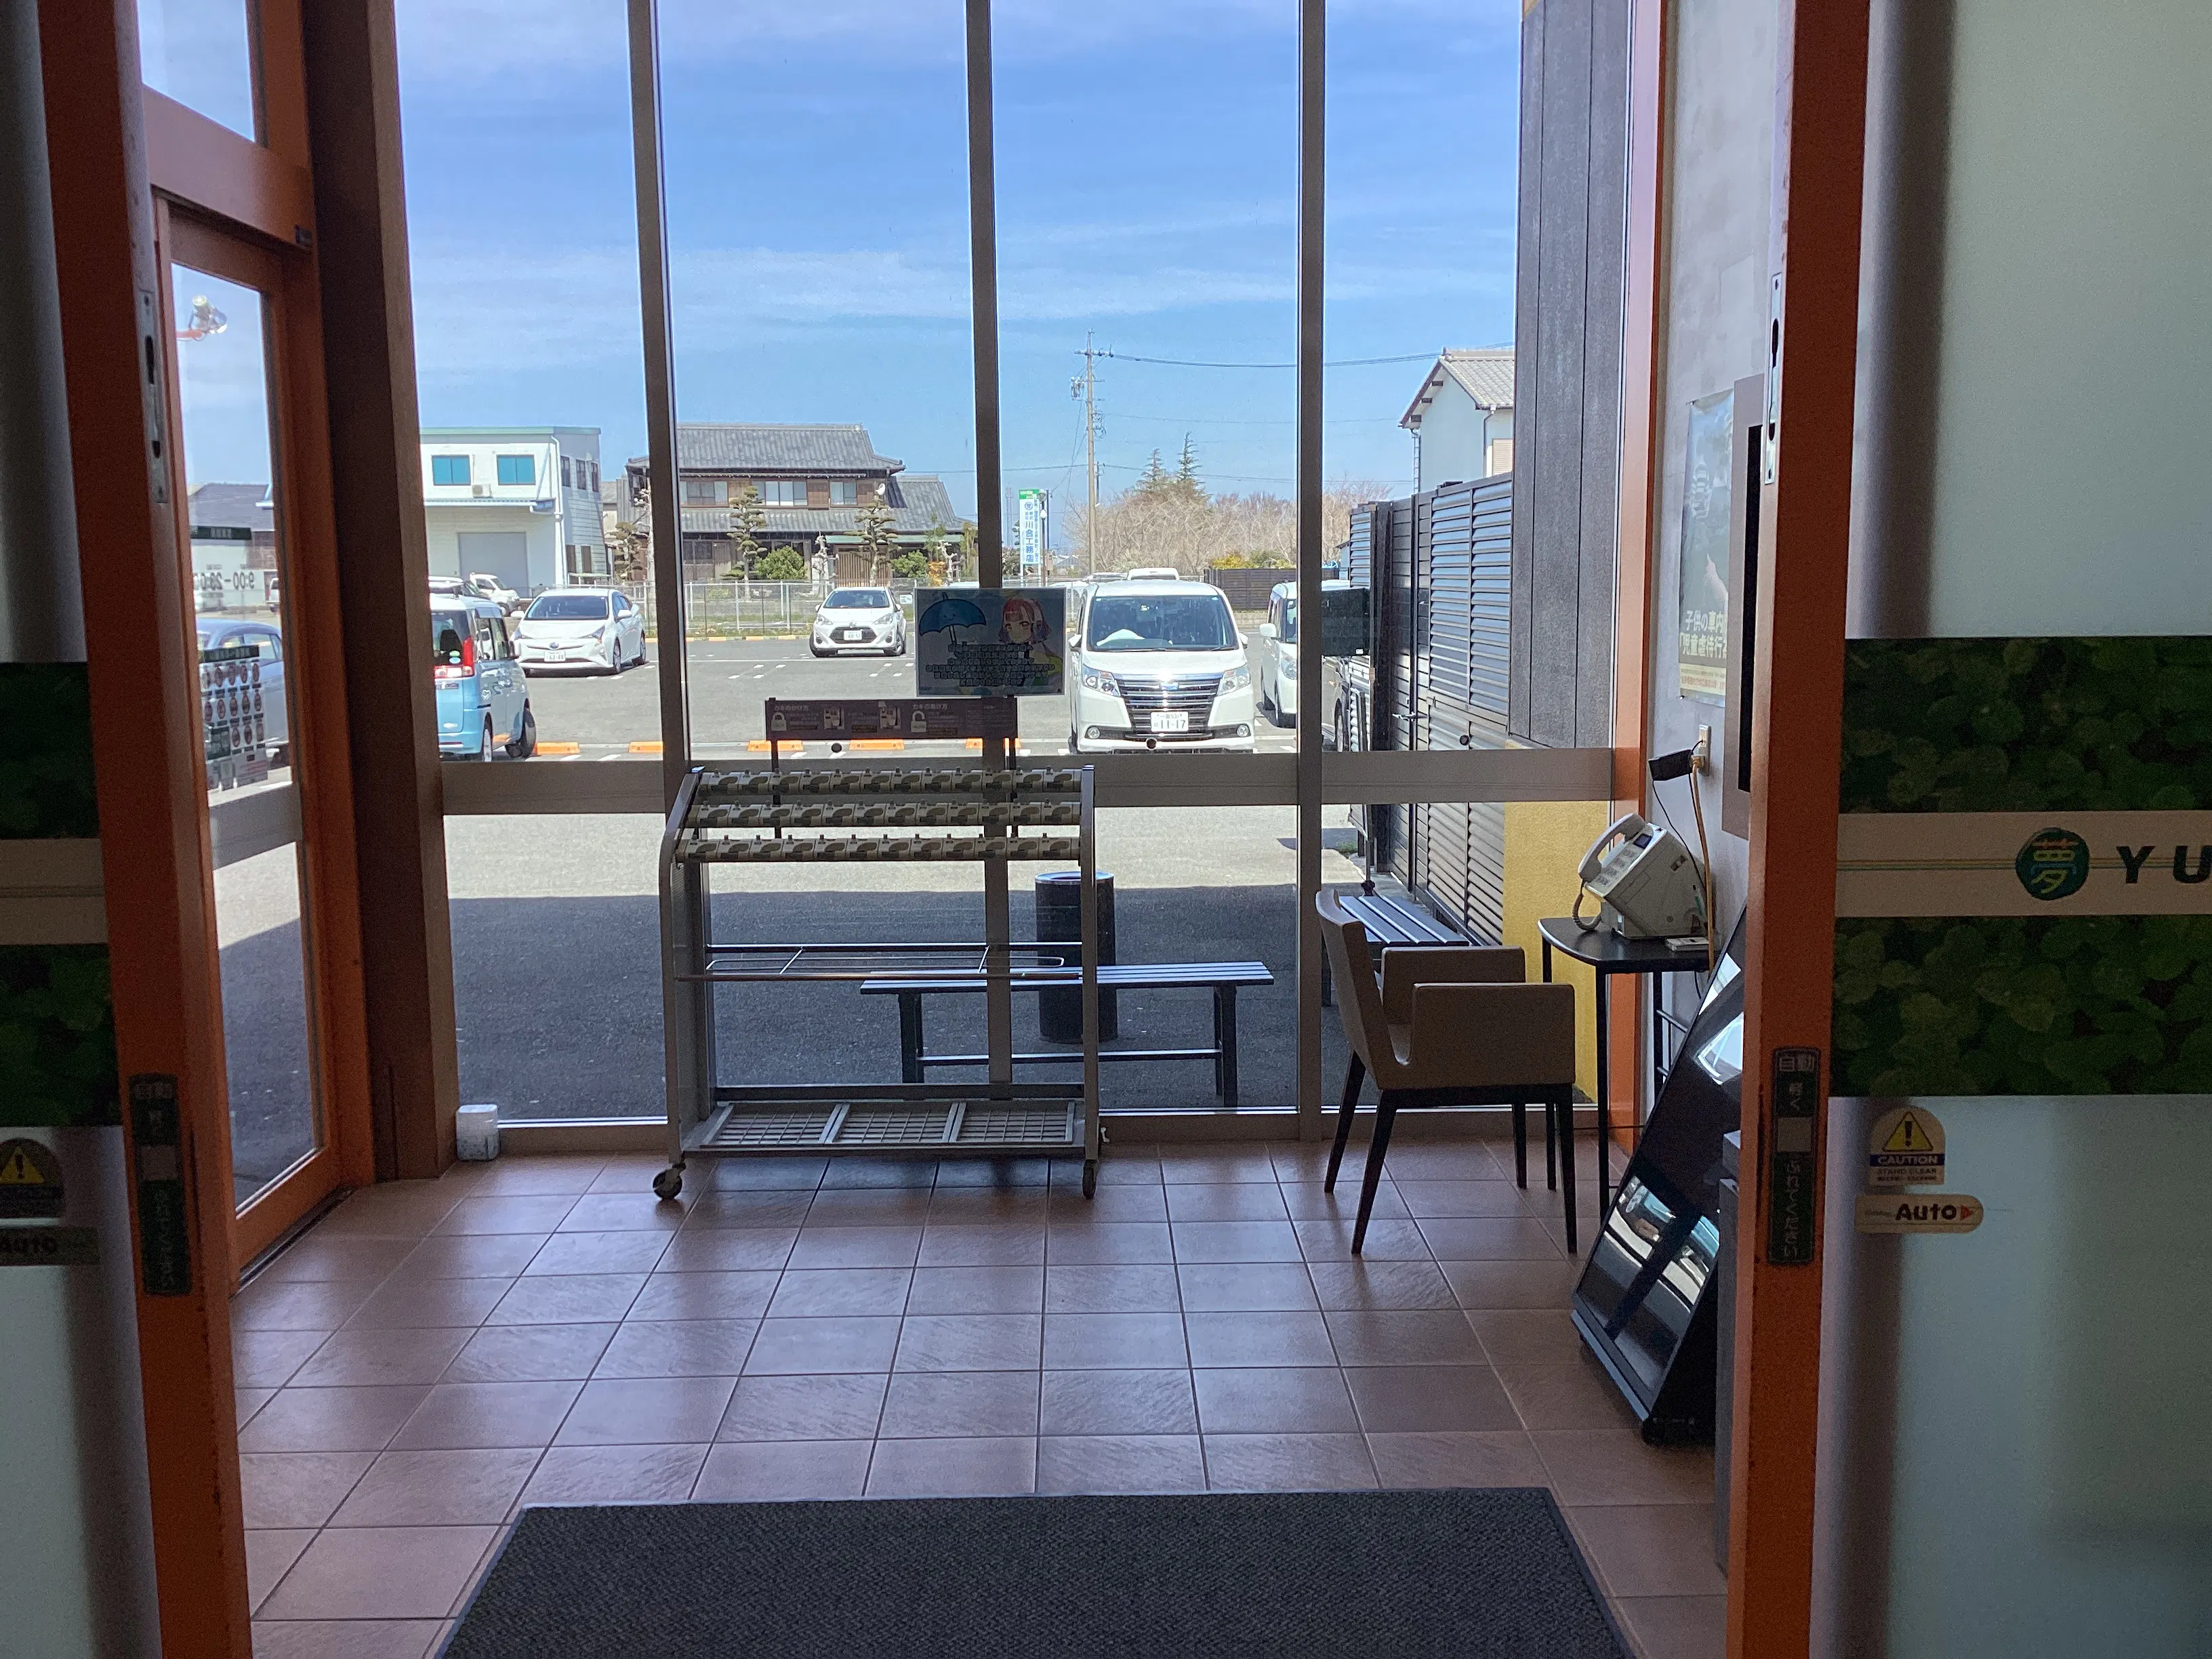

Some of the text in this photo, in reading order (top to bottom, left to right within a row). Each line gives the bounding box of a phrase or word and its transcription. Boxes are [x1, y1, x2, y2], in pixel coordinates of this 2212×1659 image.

[1025, 520, 1034, 562] 川合工務店
[1160, 720, 1186, 729] 11-17
[2030, 836, 2080, 895] 夢
[2116, 845, 2212, 884] YU
[1778, 1054, 1816, 1072] 自動
[1877, 1155, 1939, 1165] CAUTION
[1895, 1203, 1957, 1221] Auto
